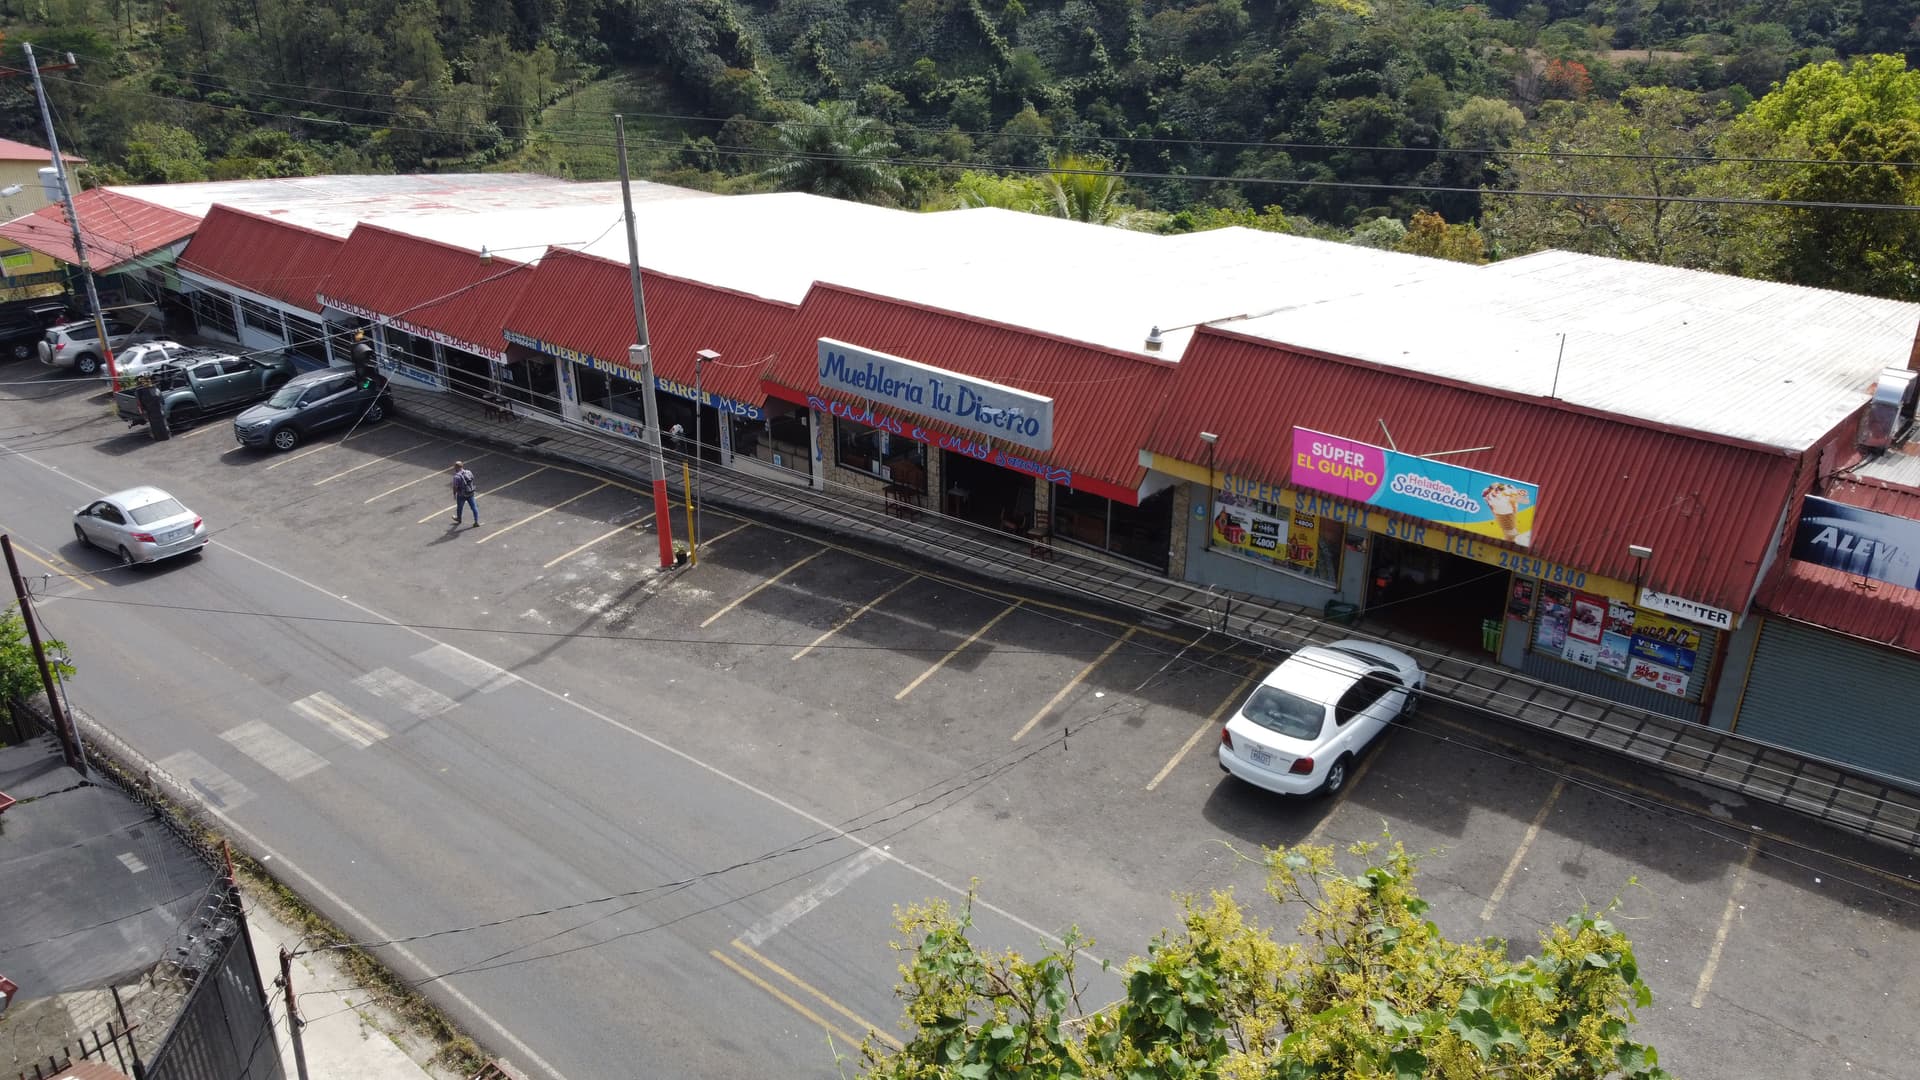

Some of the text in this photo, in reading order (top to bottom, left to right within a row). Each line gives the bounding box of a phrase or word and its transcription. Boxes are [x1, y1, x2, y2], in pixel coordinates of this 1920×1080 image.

[323, 294, 382, 322] MUEBLERIA
[540, 341, 759, 419] MUEBLE BOUTIQU SARCHI MBS
[929, 378, 952, 414] Tu
[829, 400, 902, 434] CAMAS
[1297, 452, 1378, 487] EL GUAPO
[1311, 442, 1365, 468] SÚPER
[1392, 475, 1480, 513] Sensación
[1408, 473, 1452, 494] Helados
[1223, 473, 1281, 504] SUPER
[1295, 492, 1371, 529] SARCHI
[1385, 514, 1426, 545] SUR
[1499, 551, 1586, 589] 24541840
[1637, 638, 1661, 651] VOLT
